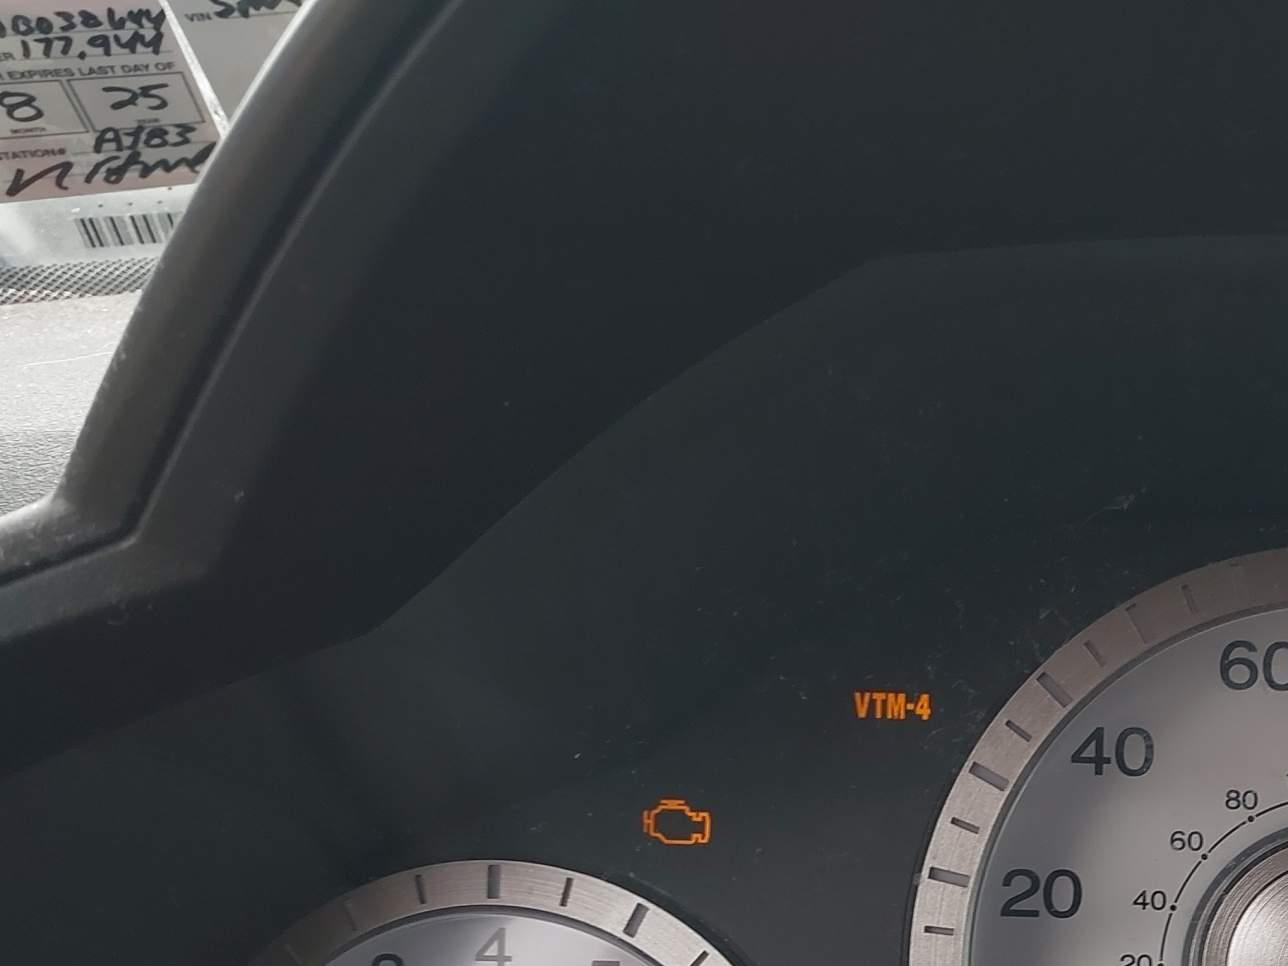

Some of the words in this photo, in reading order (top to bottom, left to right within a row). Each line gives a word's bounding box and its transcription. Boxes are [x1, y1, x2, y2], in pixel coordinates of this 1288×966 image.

[7, 67, 75, 81] EXPIRES
[79, 65, 116, 76] LAST
[121, 63, 150, 73] DAY
[154, 61, 176, 71] OF
[102, 83, 169, 110] 25
[854, 691, 931, 720] VTM-4
[1071, 727, 1154, 776] 40
[1225, 790, 1258, 810] 80
[1170, 831, 1203, 851] 60
[1000, 869, 1082, 918] 20
[1133, 890, 1166, 910] 40
